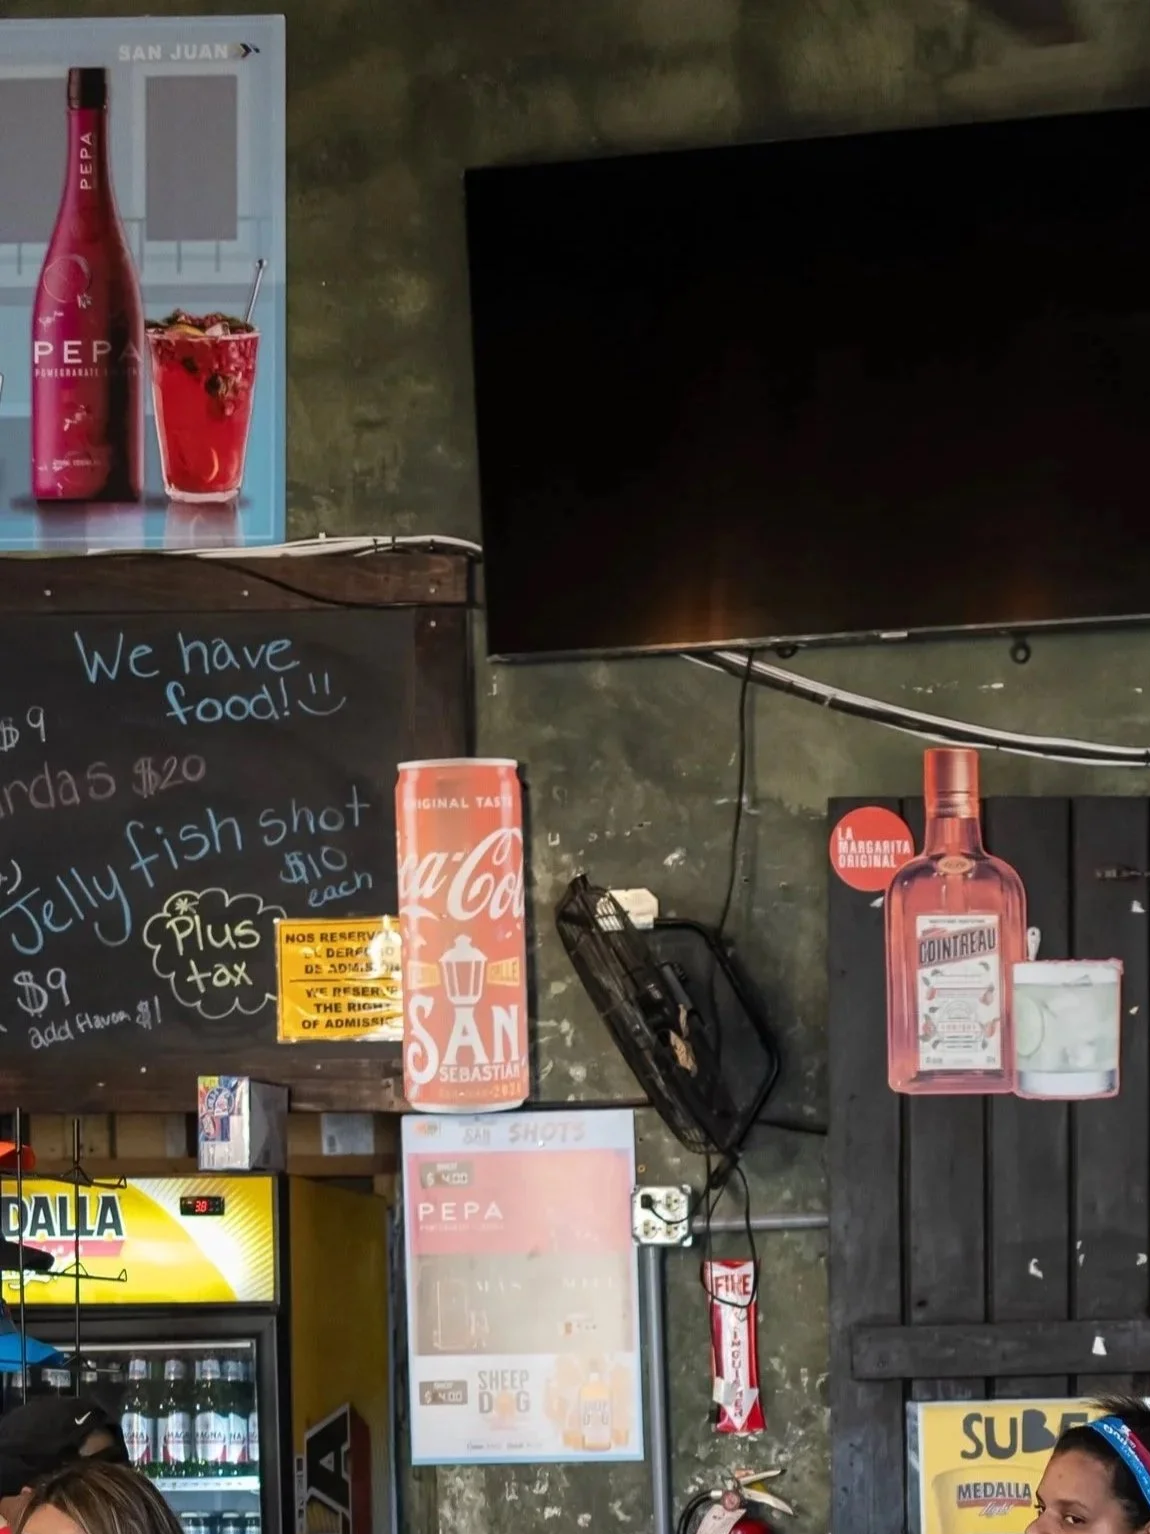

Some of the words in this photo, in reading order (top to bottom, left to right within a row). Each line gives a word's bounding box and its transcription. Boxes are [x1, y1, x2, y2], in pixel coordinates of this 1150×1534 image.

[118, 44, 163, 61] SAN
[169, 43, 229, 61] JUAN
[79, 131, 93, 190] PEPA
[34, 339, 143, 365] PEPA
[74, 631, 160, 684] We
[177, 631, 300, 675] have
[165, 676, 290, 725] food!
[0, 761, 116, 820] rdas
[132, 755, 206, 799] $20
[837, 827, 854, 840] LA
[838, 840, 911, 854] MARGARITA
[0, 865, 132, 955] Jelly
[126, 808, 242, 888] fish
[259, 785, 370, 846] shot
[280, 846, 348, 884] $10
[838, 854, 896, 868] ORIGINAL
[307, 871, 373, 907] each
[285, 933, 315, 944] NOS
[919, 928, 996, 965] COINTREAU
[187, 959, 252, 993] tax
[14, 968, 70, 1018] $9
[306, 987, 328, 998] WE
[314, 1003, 342, 1013] THE
[28, 1021, 74, 1049] add
[136, 995, 161, 1030] $1
[301, 1020, 321, 1030] OF
[407, 994, 520, 1085] SAN
[508, 1120, 586, 1144] SHOTS
[418, 1200, 504, 1222] PEPA
[713, 1274, 751, 1296] FIRE
[478, 1369, 530, 1391] SHEEP
[958, 1481, 1032, 1500] MEDALLA
